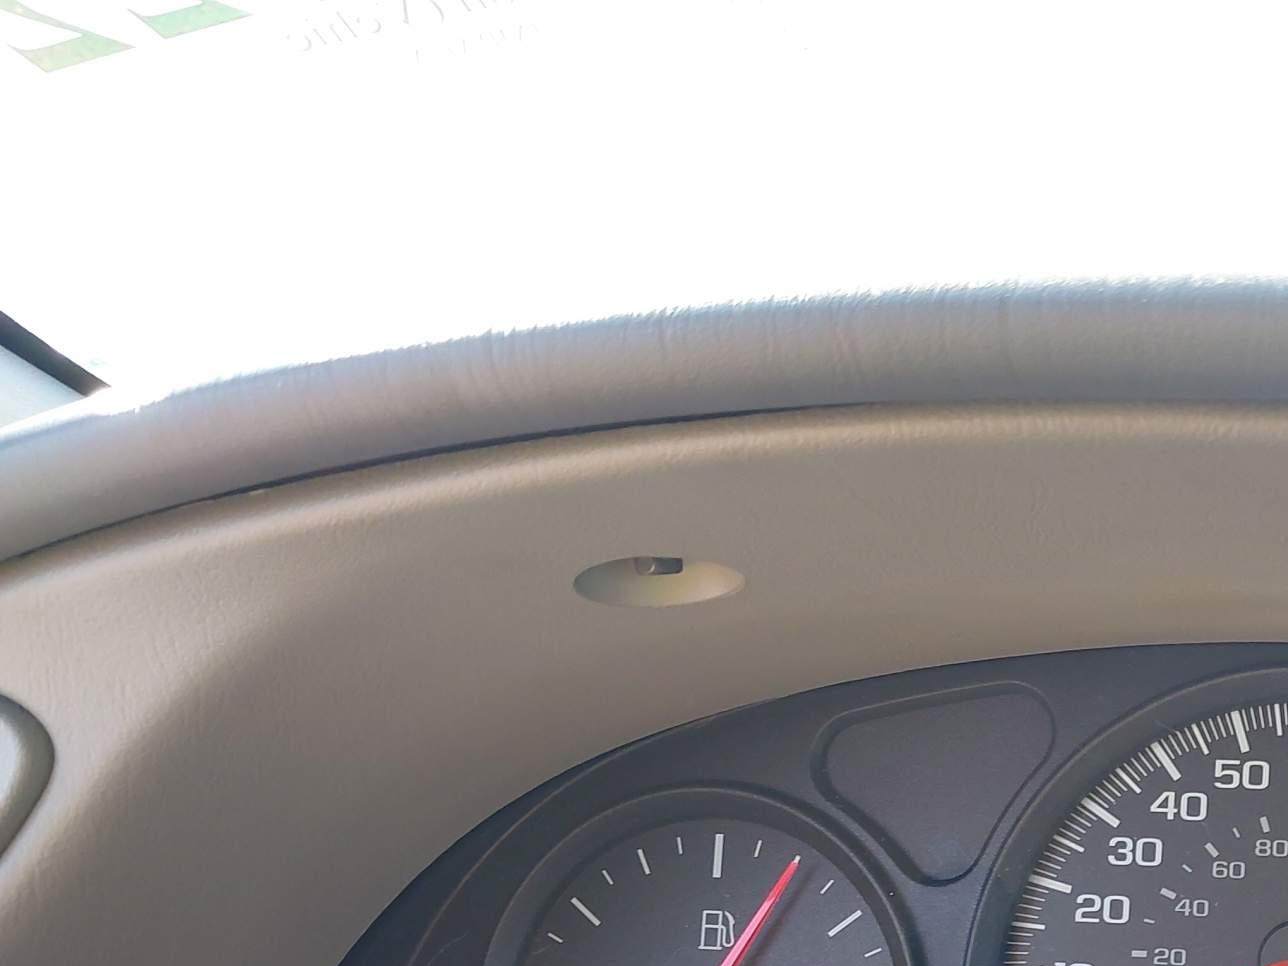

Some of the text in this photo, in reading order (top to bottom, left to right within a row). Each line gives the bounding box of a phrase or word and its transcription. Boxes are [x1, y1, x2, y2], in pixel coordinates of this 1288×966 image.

[1214, 759, 1270, 789] 50
[1150, 792, 1208, 821] 40
[1107, 837, 1164, 867] 30
[1254, 839, 1288, 858] 80
[1211, 861, 1246, 880] 60
[1074, 895, 1131, 924] 20
[1174, 899, 1209, 917] 40
[1153, 948, 1187, 966] 20
